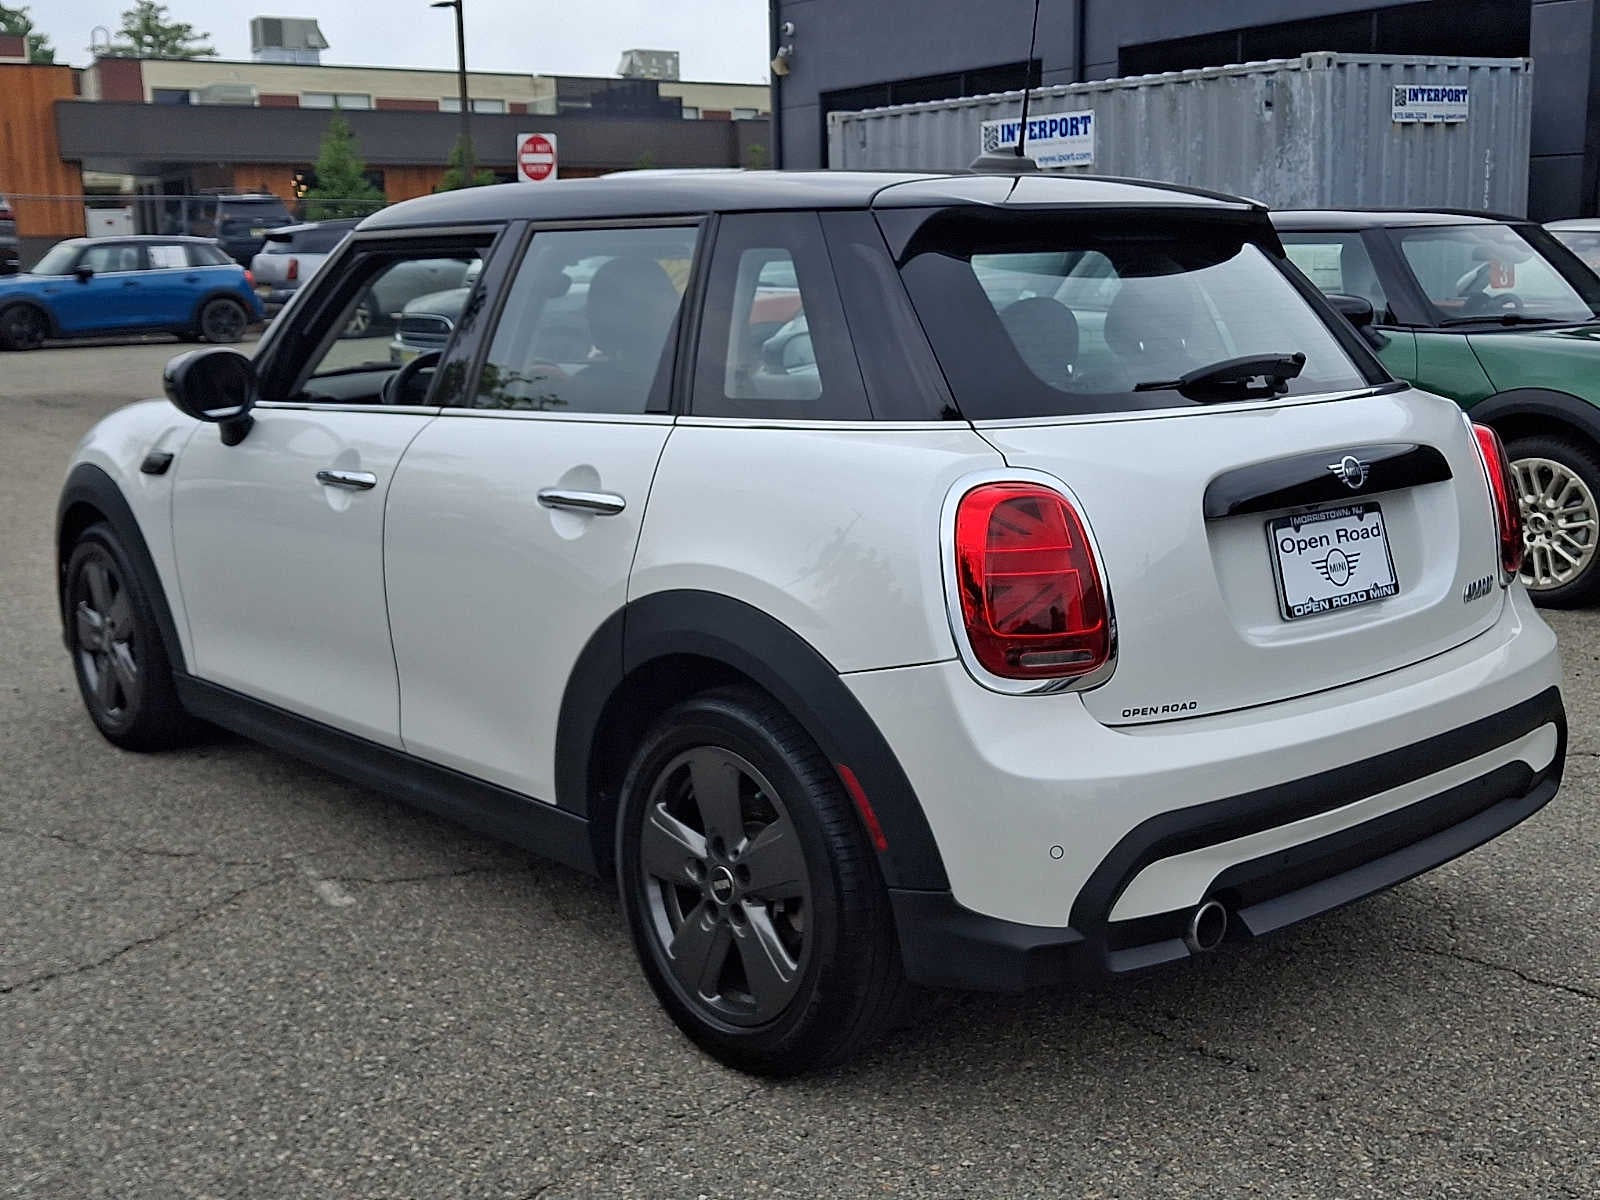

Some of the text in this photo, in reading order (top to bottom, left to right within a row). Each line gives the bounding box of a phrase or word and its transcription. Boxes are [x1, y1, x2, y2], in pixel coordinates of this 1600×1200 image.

[1408, 87, 1468, 103] INTERPORT
[1001, 115, 1092, 143] INERPORT
[1280, 522, 1382, 555] Open Road
[1329, 563, 1347, 573] MINI
[1293, 585, 1395, 617] OPEN ROAD MINI
[1122, 701, 1197, 718] OPEN ROAD
